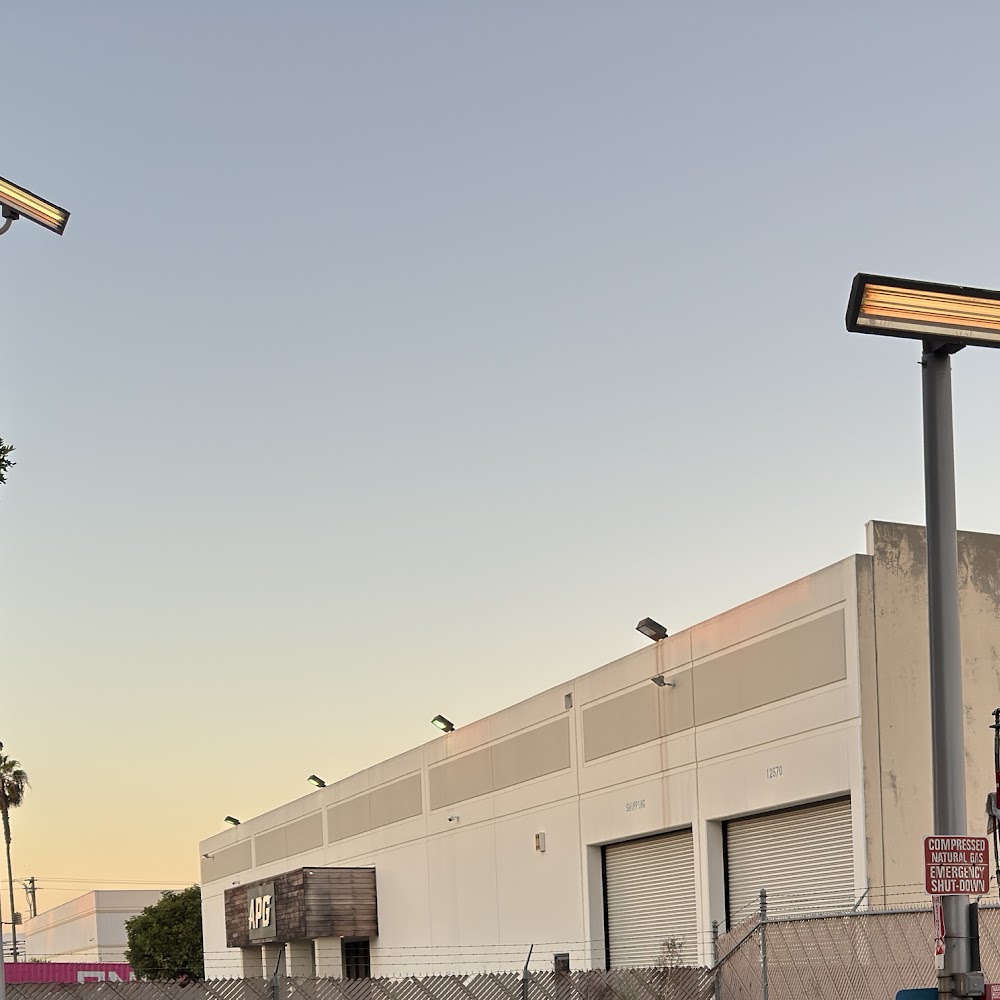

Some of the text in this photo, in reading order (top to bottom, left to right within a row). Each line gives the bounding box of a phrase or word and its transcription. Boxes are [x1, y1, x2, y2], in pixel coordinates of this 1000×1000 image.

[766, 765, 783, 779] 12570
[626, 799, 646, 812] SHIPPING
[928, 838, 986, 851] COMPRESSED
[932, 852, 984, 863] NATURAL GAS
[930, 866, 985, 879] EMERGENCY
[931, 880, 985, 892] SHUT-DOWN
[248, 895, 272, 930] APG
